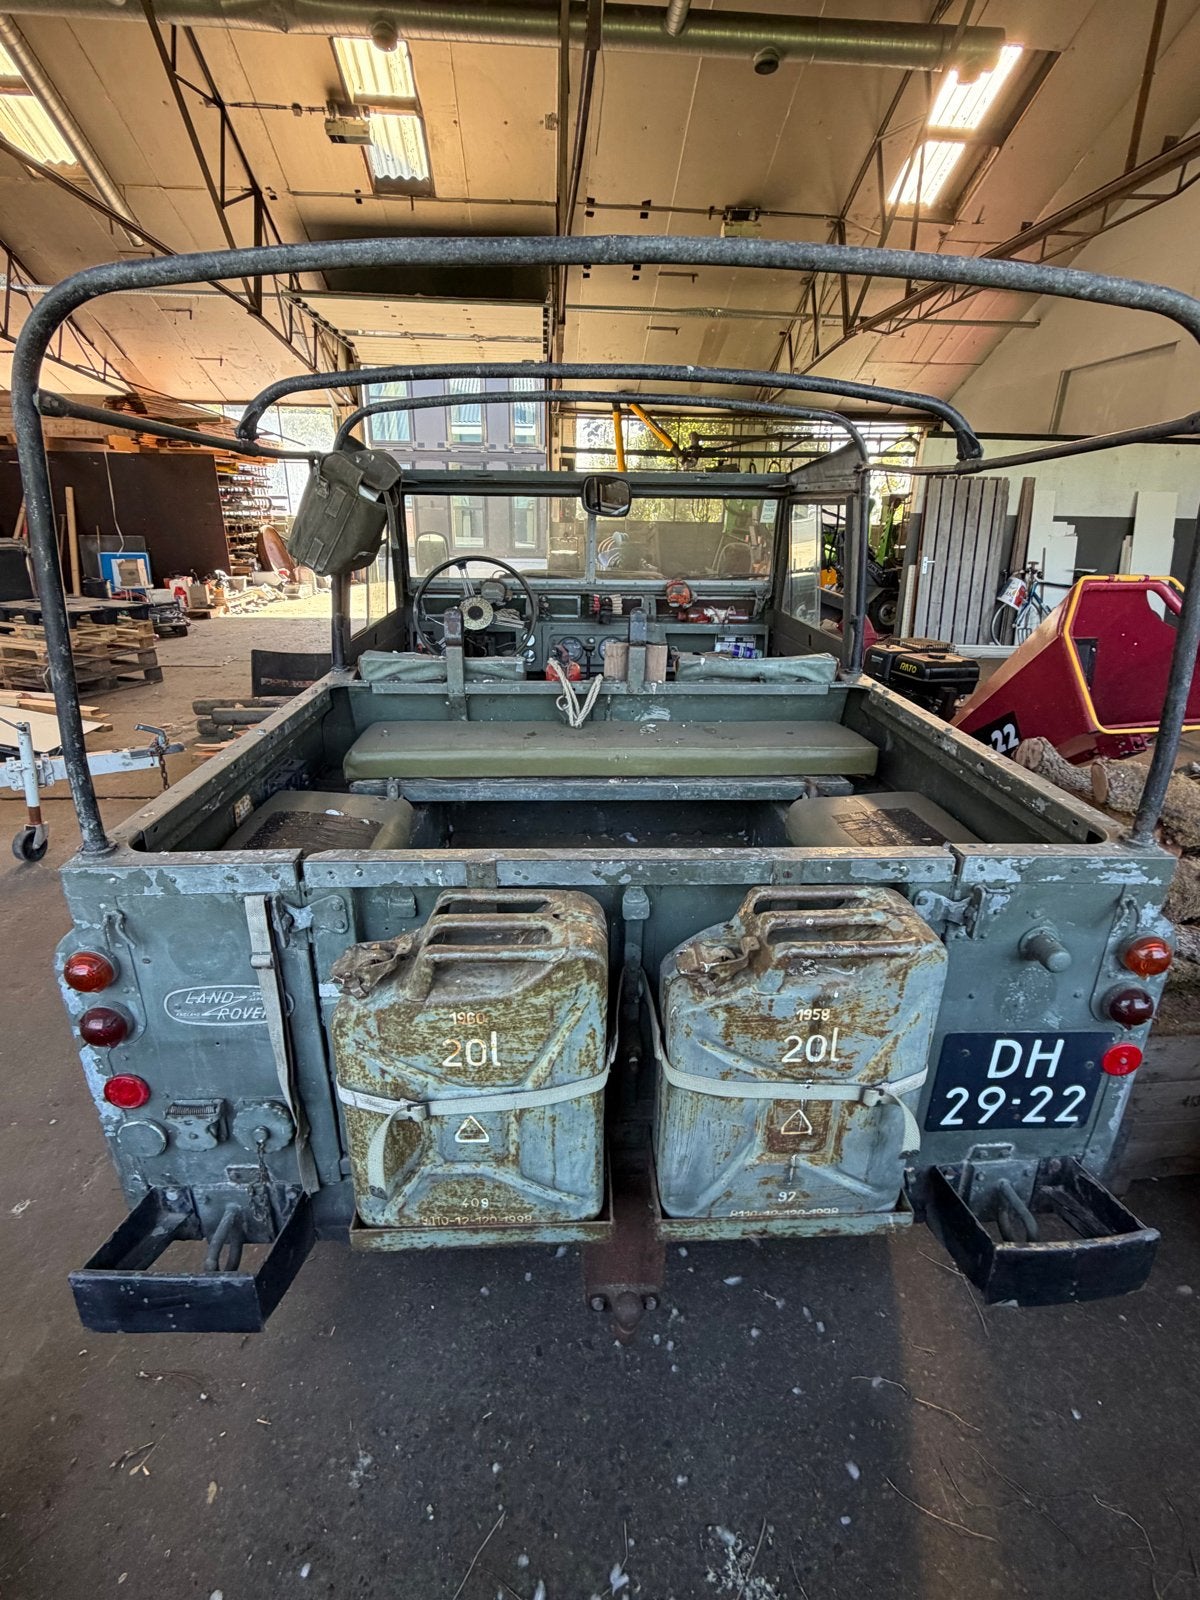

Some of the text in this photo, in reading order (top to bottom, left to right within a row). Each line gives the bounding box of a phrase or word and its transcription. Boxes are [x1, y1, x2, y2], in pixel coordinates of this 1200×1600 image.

[900, 662, 917, 674] RATO
[185, 991, 234, 1004] LAND
[216, 1007, 266, 1020] ROVE
[449, 1011, 485, 1025] 1960
[796, 1008, 831, 1021] 1958
[987, 1039, 1064, 1078] DH
[940, 1085, 1086, 1125] 29-22
[462, 1197, 489, 1209] 409
